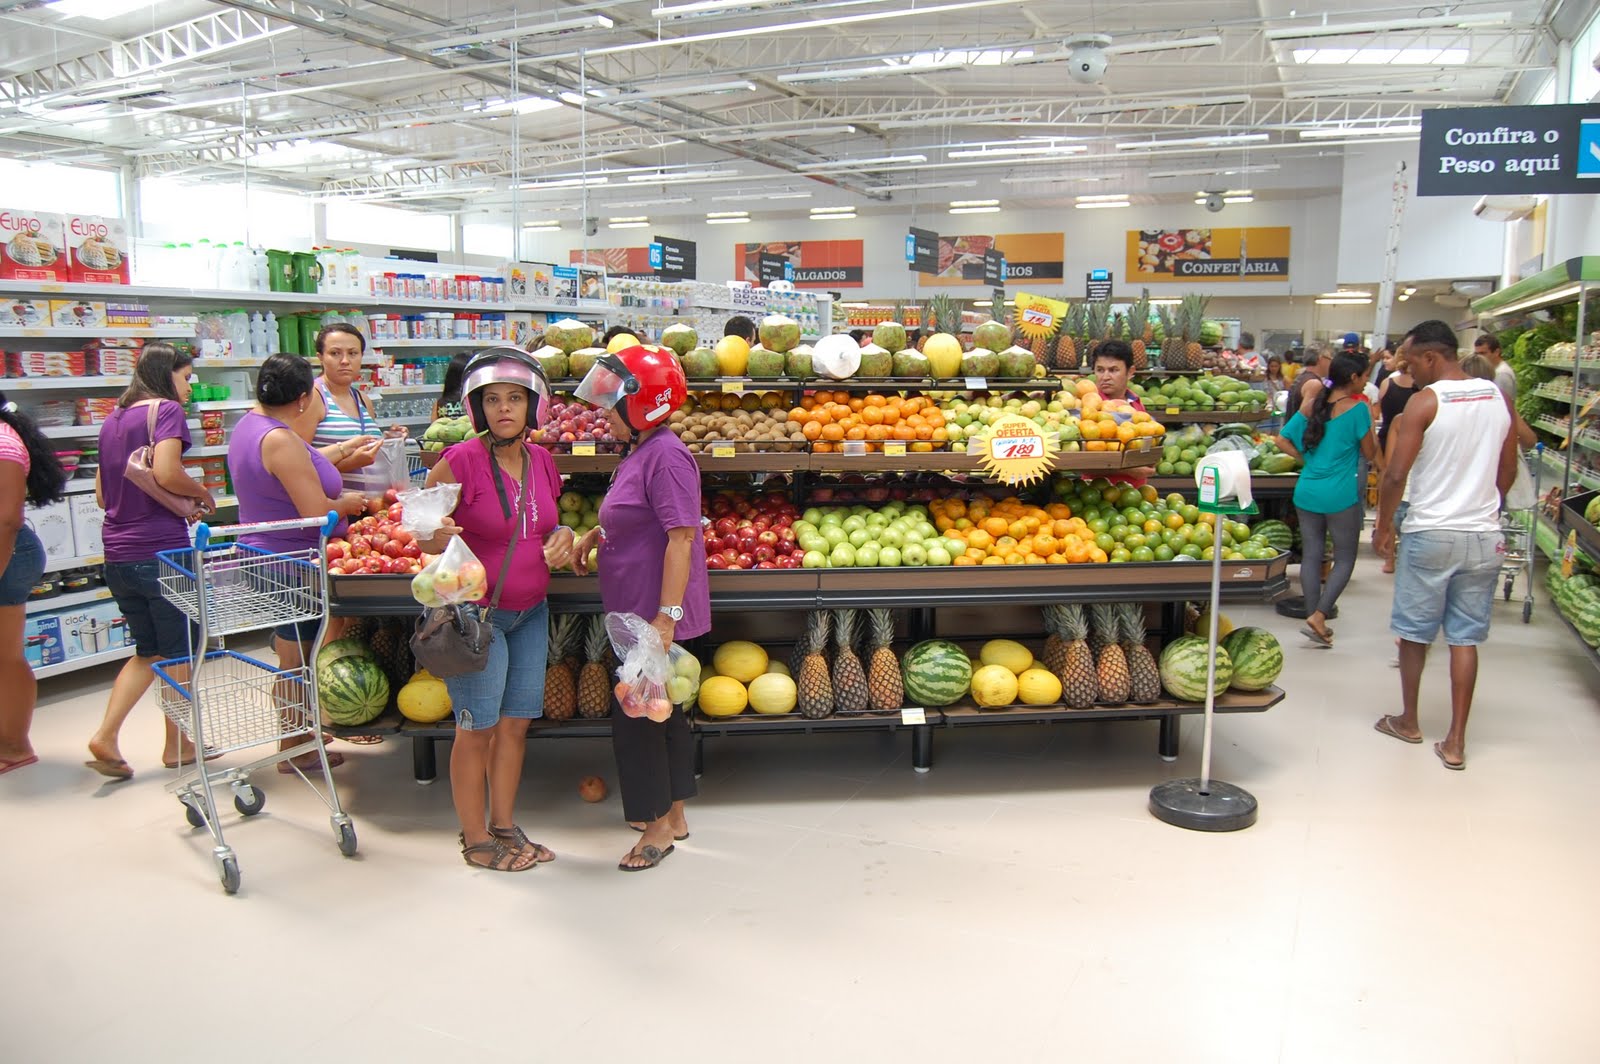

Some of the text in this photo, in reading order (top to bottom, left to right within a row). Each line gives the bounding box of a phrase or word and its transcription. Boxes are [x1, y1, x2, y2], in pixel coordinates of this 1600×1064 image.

[1445, 127, 1560, 146] Confira o
[1439, 154, 1561, 176] Peso aqui
[0, 212, 41, 233] EURO
[71, 218, 108, 237] EURO
[650, 248, 661, 264] 05
[1004, 266, 1033, 276] RIOS
[996, 428, 1035, 437] OFERTA
[65, 613, 89, 626] clock
